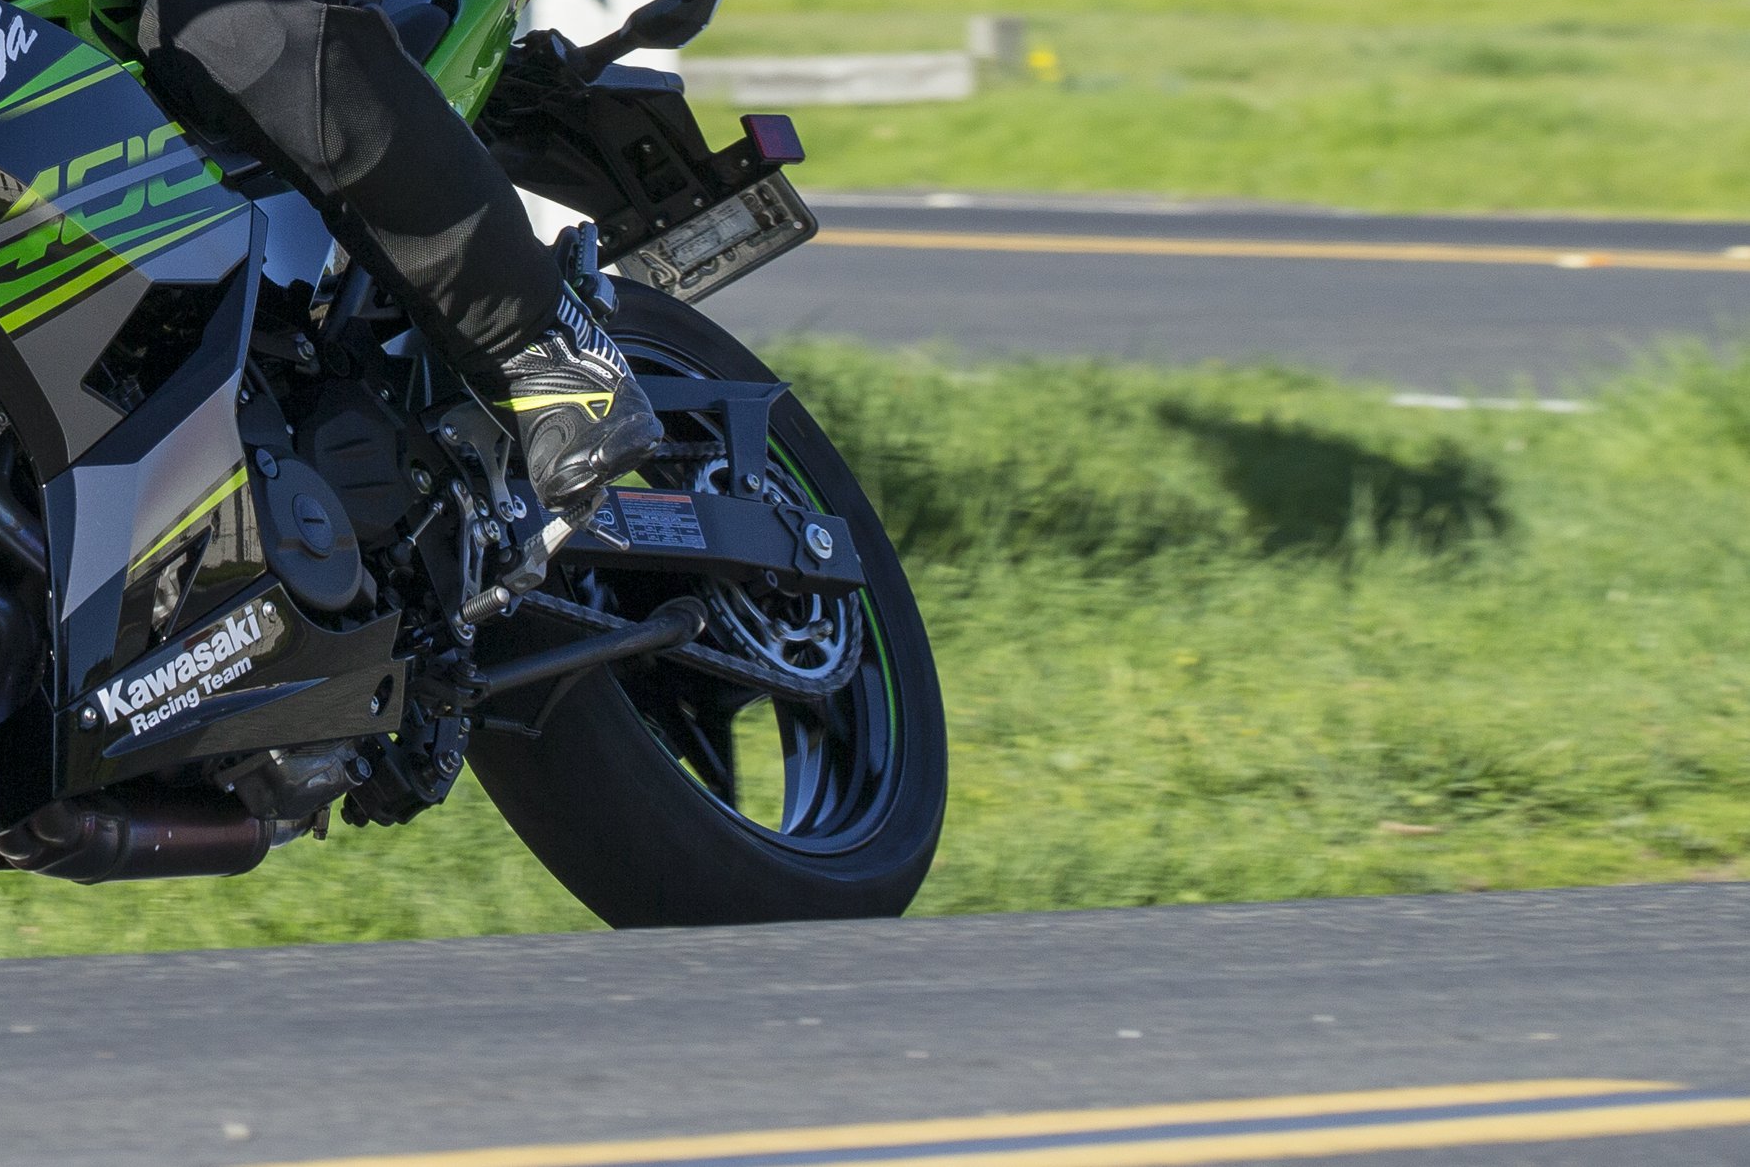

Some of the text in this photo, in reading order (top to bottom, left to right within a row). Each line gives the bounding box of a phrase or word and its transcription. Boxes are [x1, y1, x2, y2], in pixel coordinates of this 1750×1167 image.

[96, 604, 262, 725] Kawasaki
[130, 656, 253, 737] Racing Team
